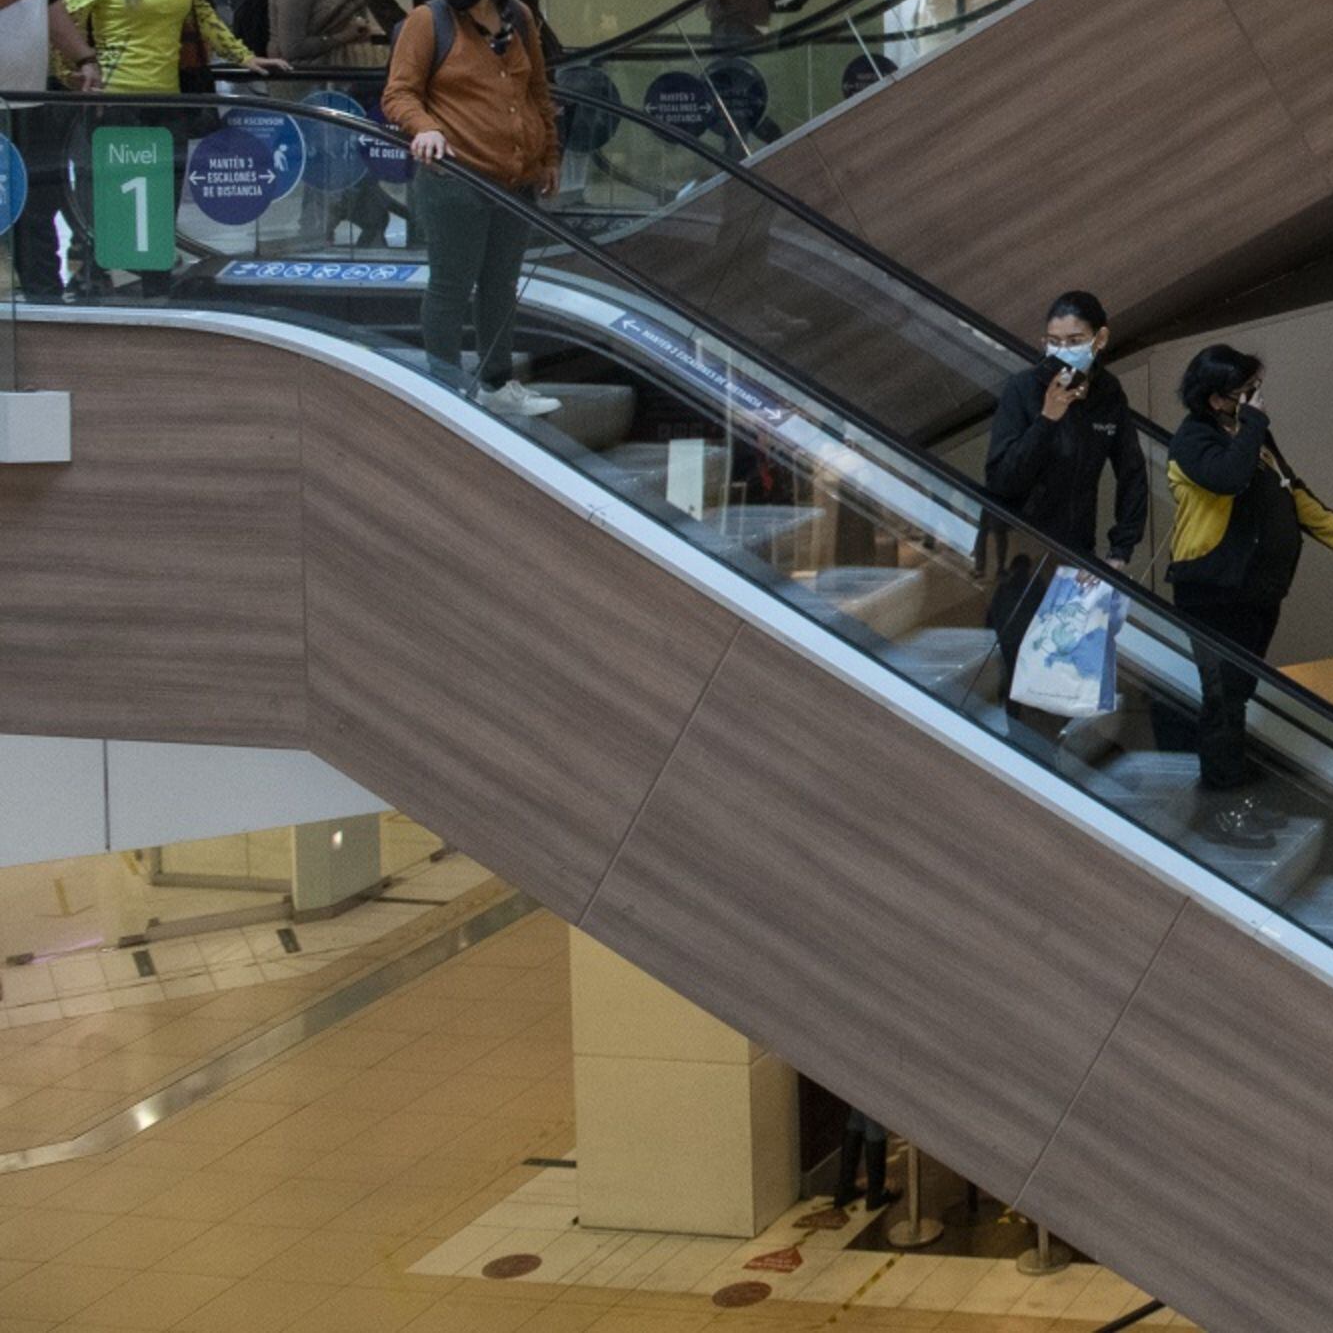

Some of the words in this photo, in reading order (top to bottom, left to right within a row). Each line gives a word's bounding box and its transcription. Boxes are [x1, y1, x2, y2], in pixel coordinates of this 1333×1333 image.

[108, 143, 157, 165] Nivel
[209, 155, 246, 169] MANTÉN
[206, 169, 257, 184] ESCALONES
[202, 186, 216, 198] DE
[217, 185, 263, 198] DISTANCIA
[121, 176, 149, 252] 1
